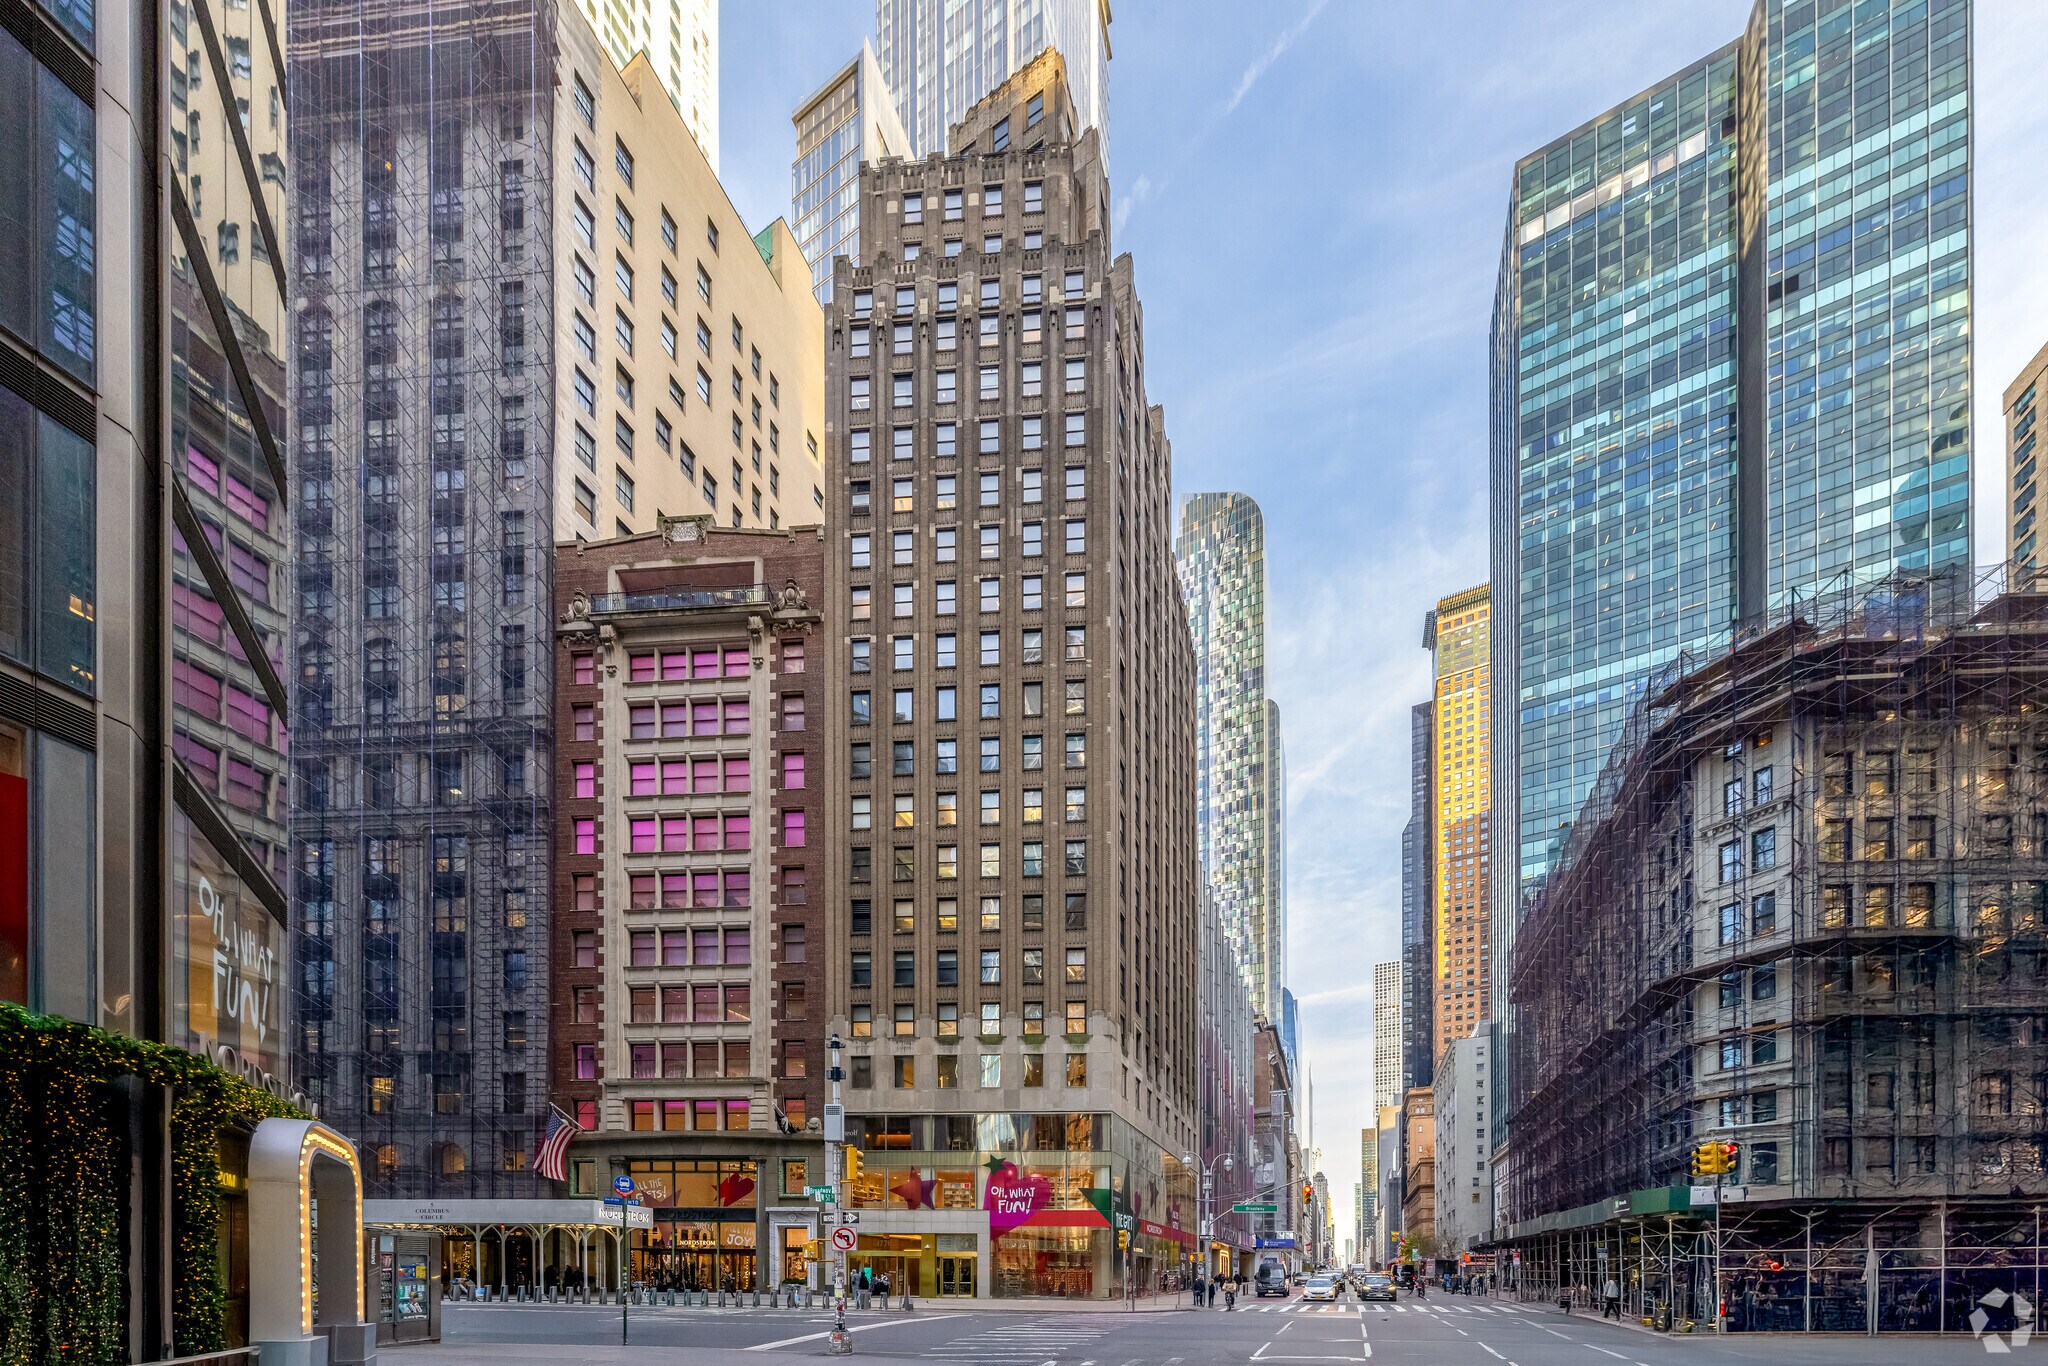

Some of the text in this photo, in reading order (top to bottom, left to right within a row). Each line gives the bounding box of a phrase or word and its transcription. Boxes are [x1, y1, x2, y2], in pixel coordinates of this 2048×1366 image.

[199, 876, 274, 983] OH, WHAT
[213, 948, 268, 1044] FUN!
[635, 1186, 667, 1202] GFTS!
[991, 1186, 1035, 1199] OH, WHAT
[998, 1197, 1032, 1214] FUN!
[598, 1207, 649, 1223] NORDTROM
